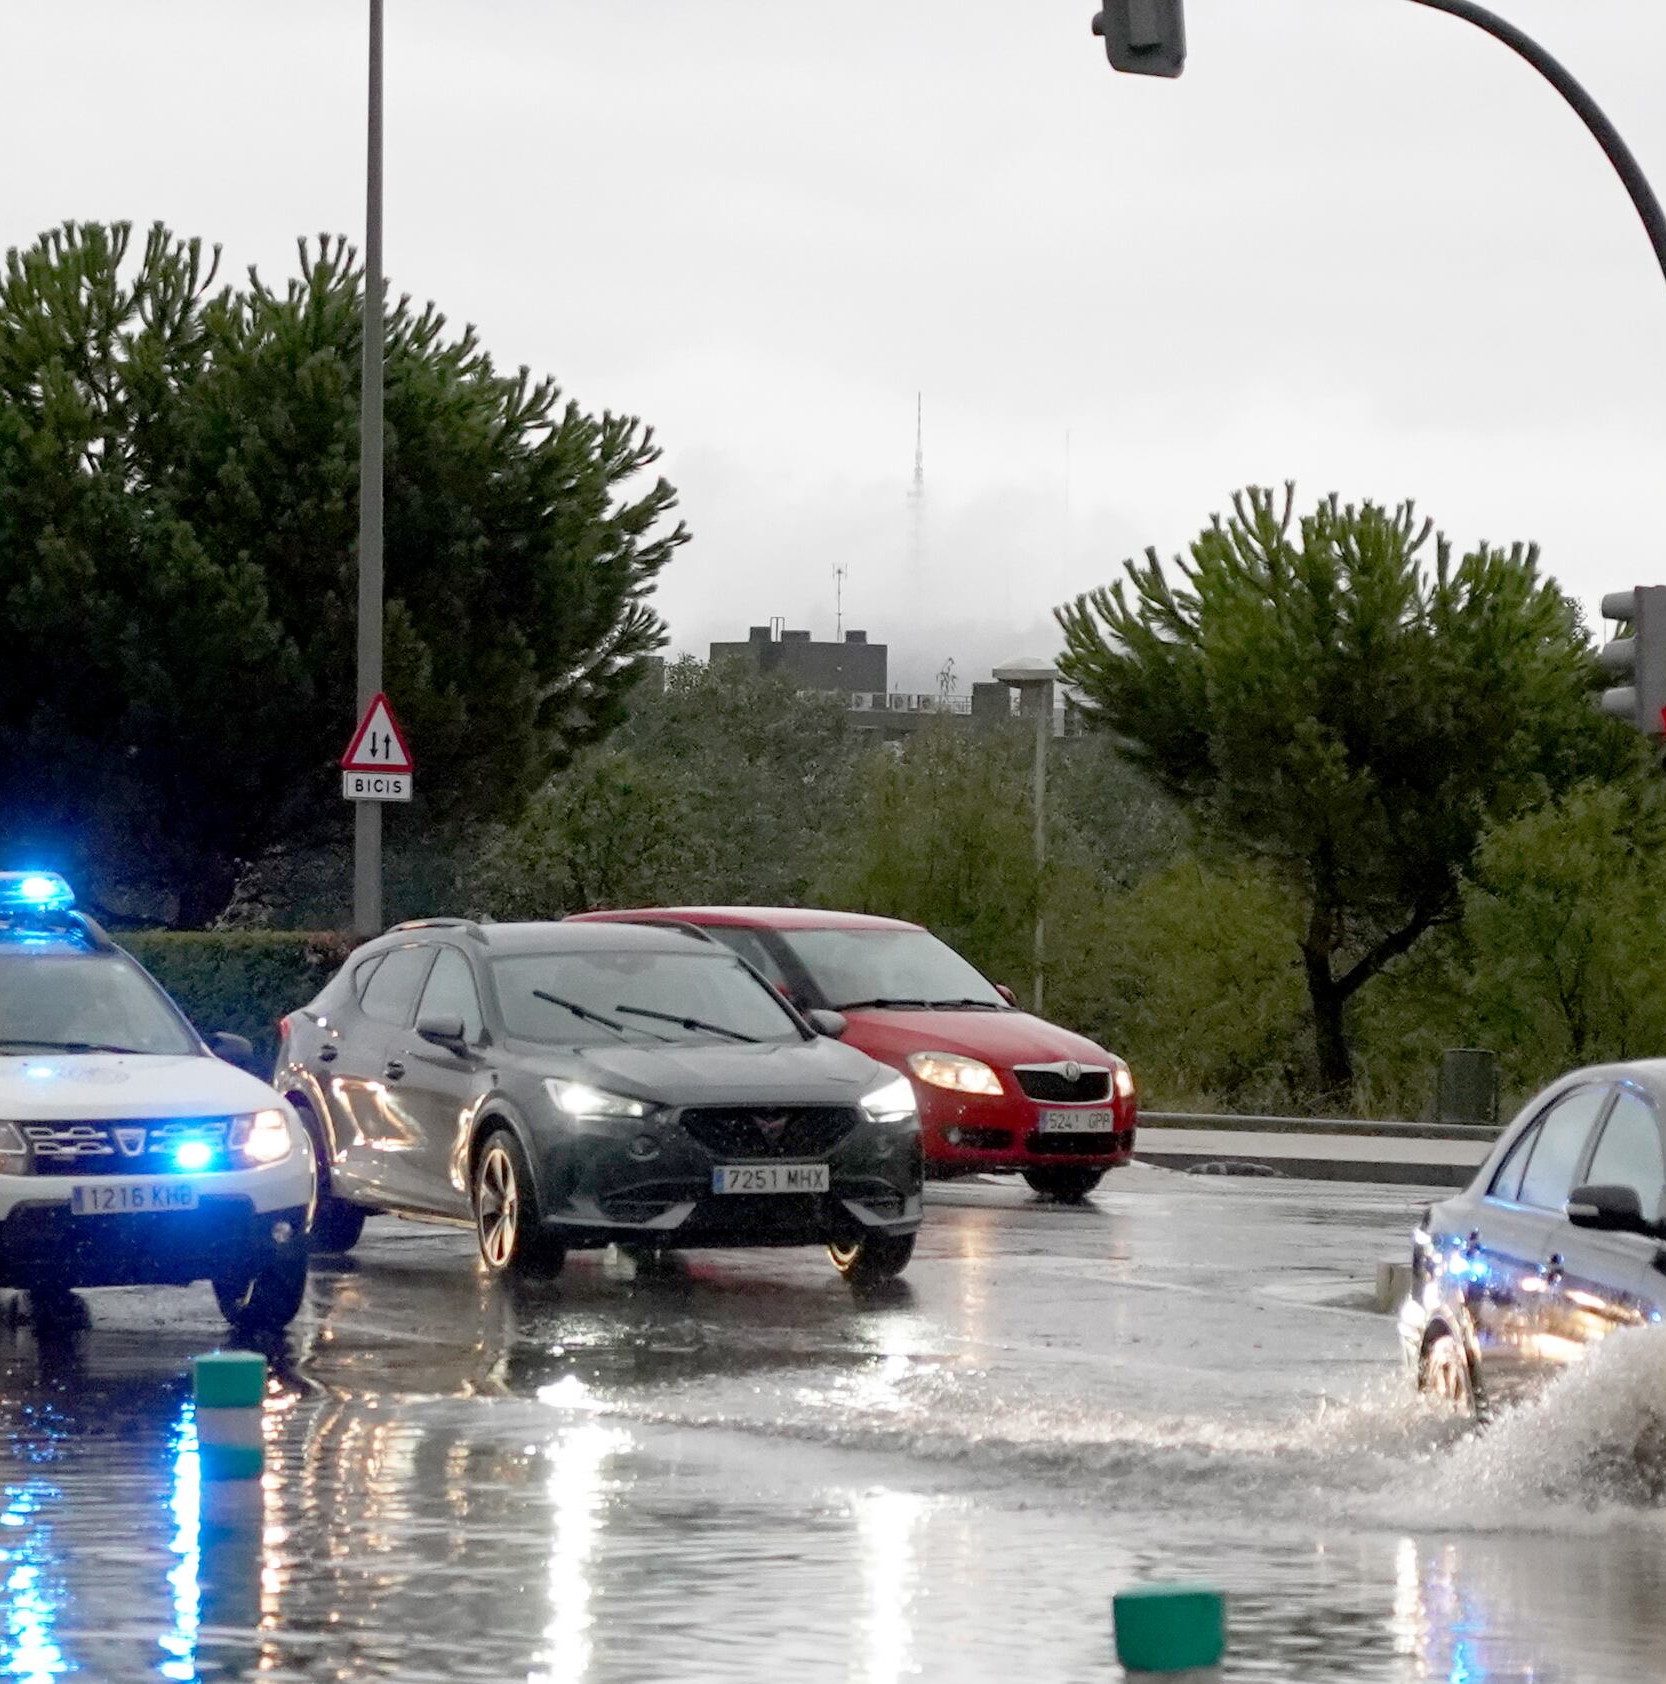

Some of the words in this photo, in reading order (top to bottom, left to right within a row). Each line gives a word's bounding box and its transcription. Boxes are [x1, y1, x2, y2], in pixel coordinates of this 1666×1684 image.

[355, 778, 402, 794] BICIS
[729, 1169, 778, 1189] 7251
[787, 1168, 824, 1188] MHX
[91, 1186, 144, 1209] 1216
